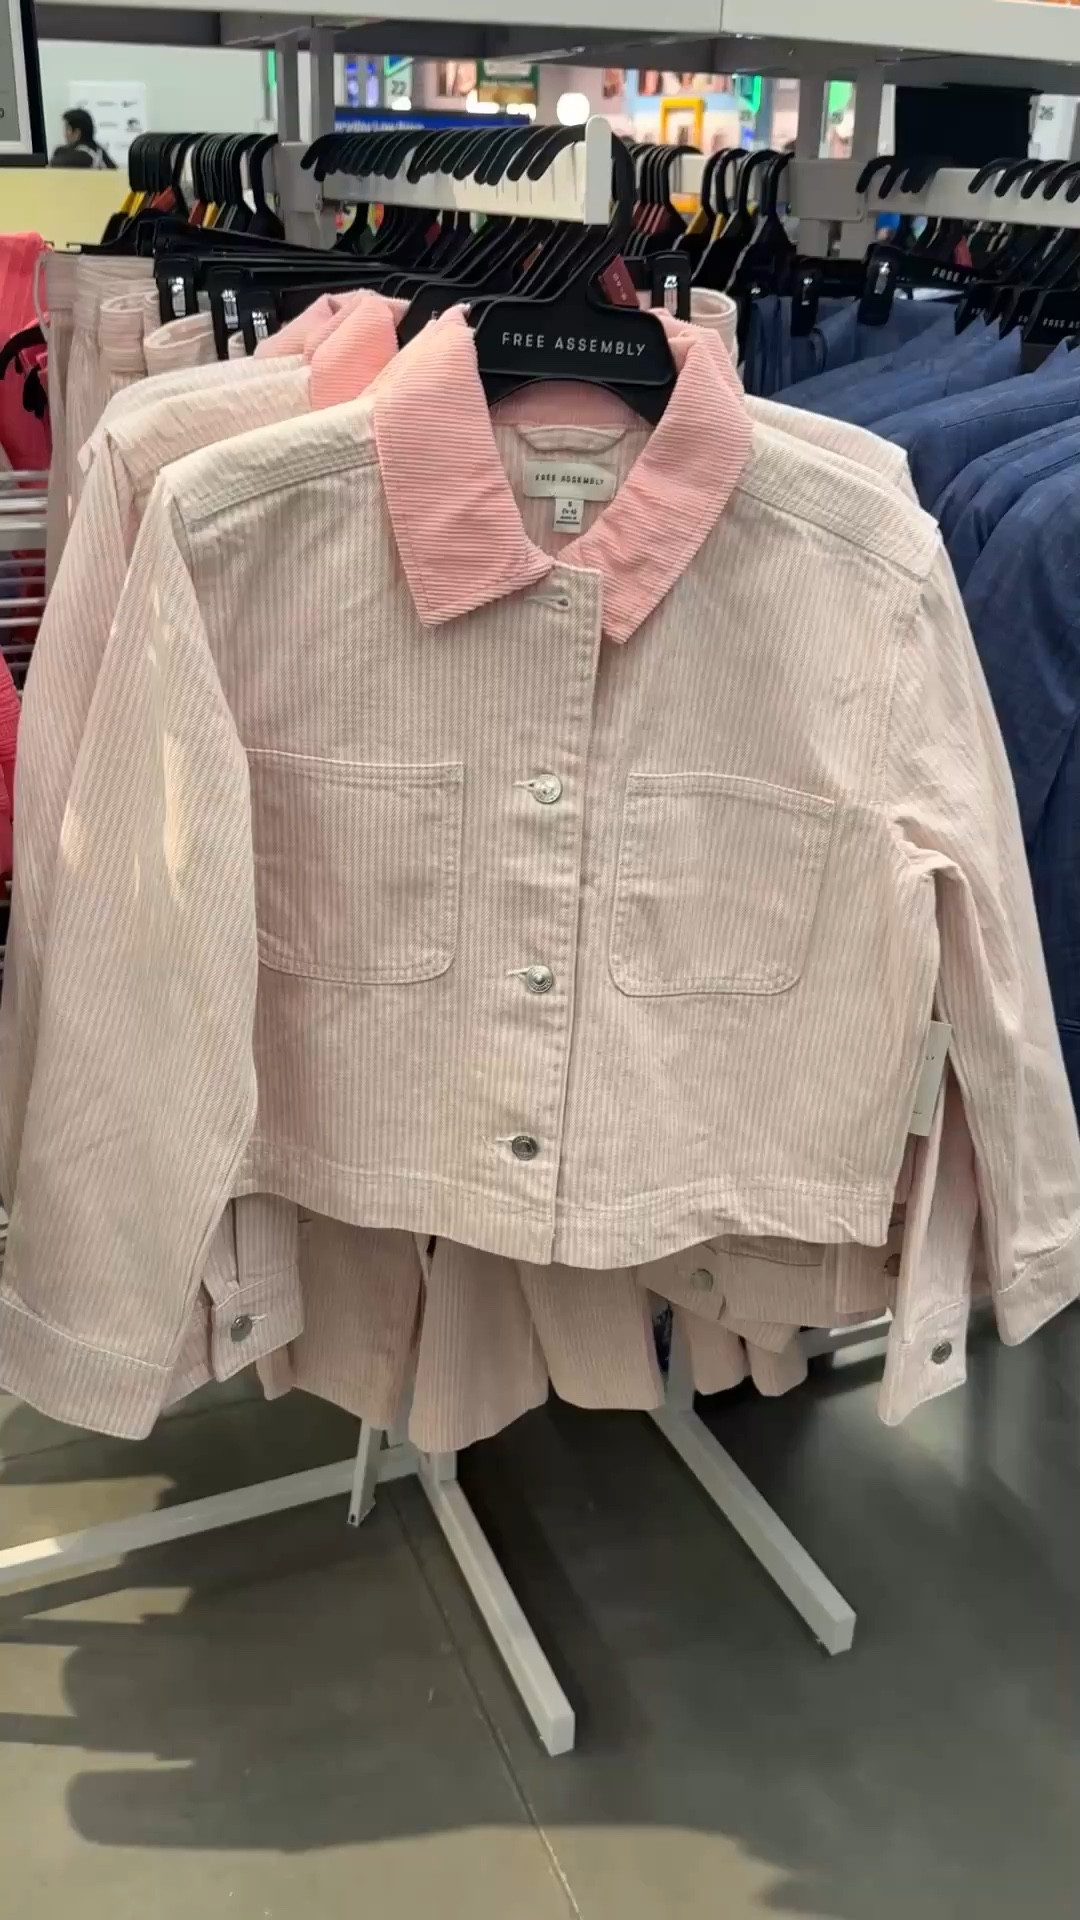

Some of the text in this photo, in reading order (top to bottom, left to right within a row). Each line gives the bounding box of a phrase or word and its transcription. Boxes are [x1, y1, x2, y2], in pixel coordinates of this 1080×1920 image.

[391, 80, 407, 95] 22
[502, 332, 646, 356] FREE ASSEMBLY
[535, 473, 604, 486] FREE ASSEMBLY
